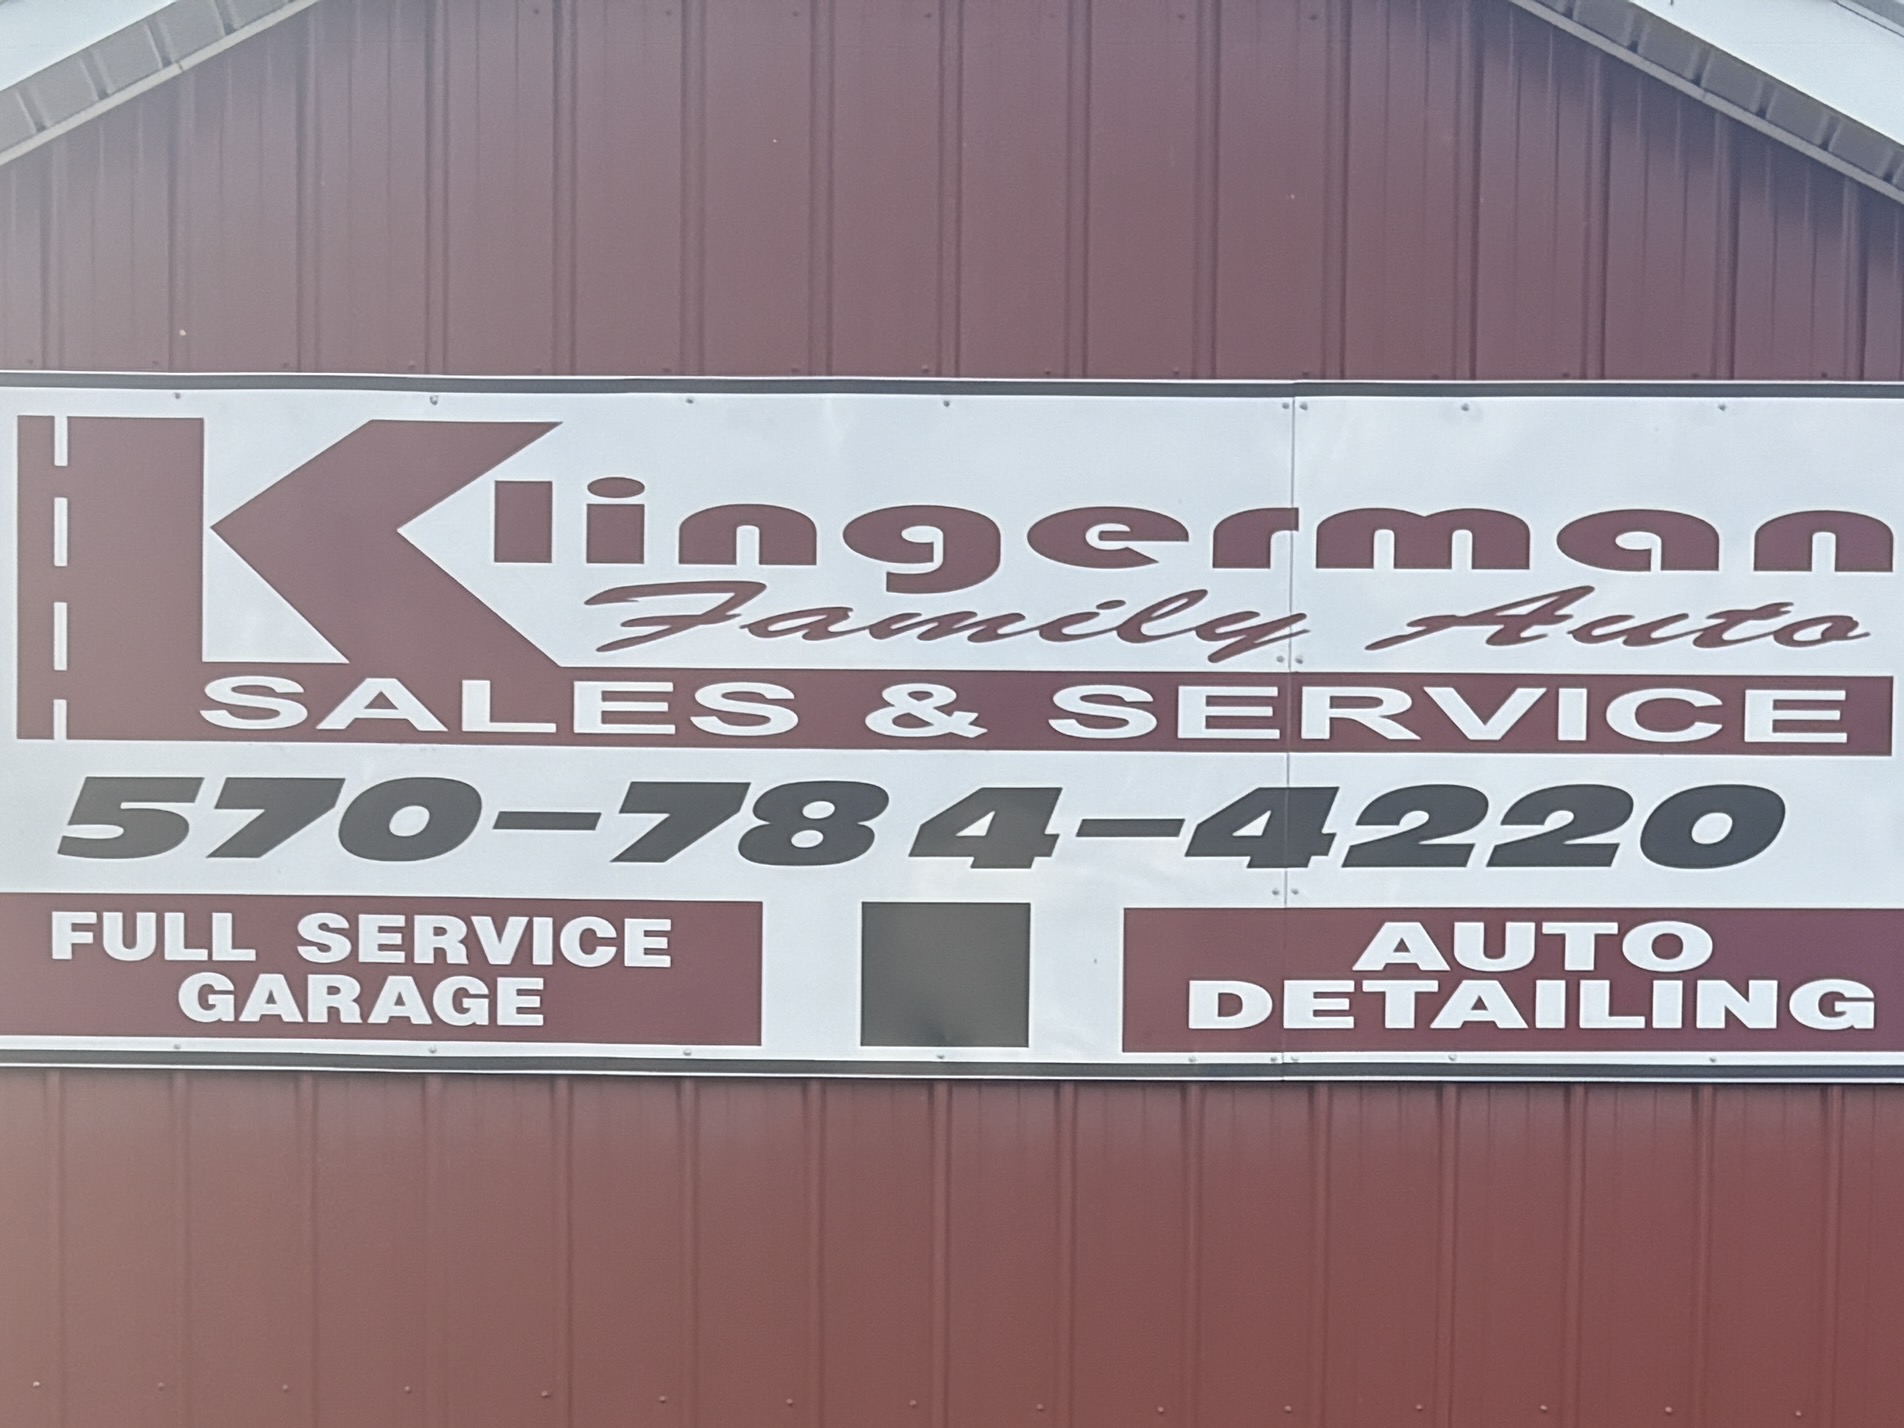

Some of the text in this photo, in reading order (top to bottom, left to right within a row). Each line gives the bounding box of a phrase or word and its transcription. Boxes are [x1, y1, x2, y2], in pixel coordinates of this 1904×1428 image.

[17, 415, 1894, 690] Klingerman
[583, 580, 1871, 664] Family Auto
[198, 674, 1849, 745] SALES & SERVICE
[56, 776, 1786, 870] 570-784-4220
[50, 910, 673, 969] FULL SERVICE
[1352, 920, 1715, 973] AUTO
[177, 972, 545, 1028] GARAGE
[1186, 979, 1876, 1031] DETAILING
